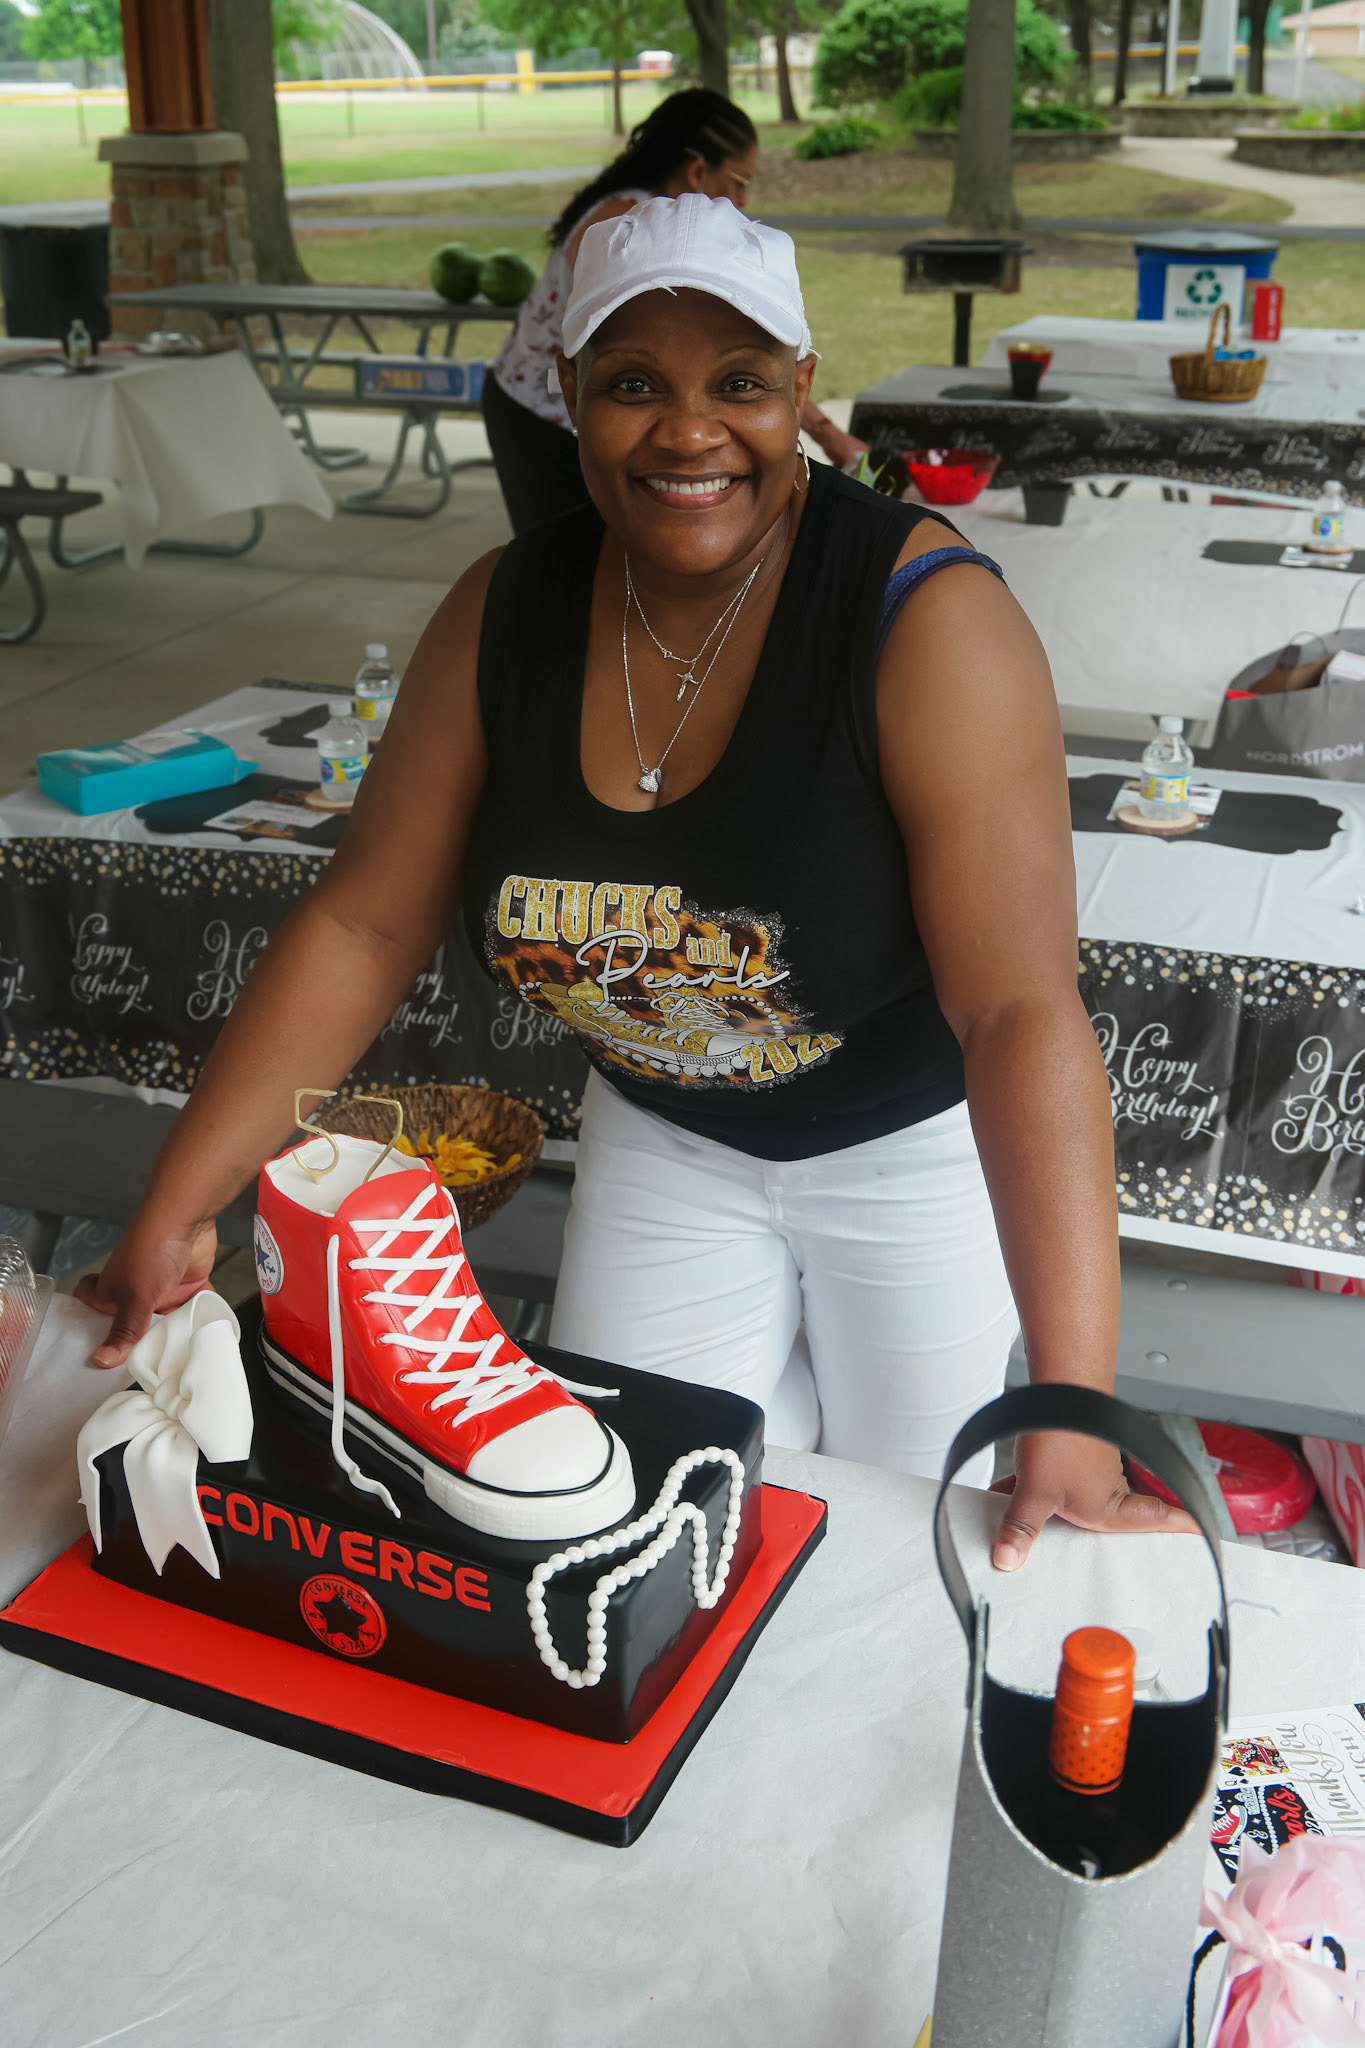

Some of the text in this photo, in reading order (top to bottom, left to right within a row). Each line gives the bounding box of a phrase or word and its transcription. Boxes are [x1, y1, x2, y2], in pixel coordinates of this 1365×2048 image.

[497, 875, 734, 967] CHUCKS and
[576, 929, 790, 1002] Pearls
[739, 1033, 843, 1082] 2021
[1089, 1012, 1215, 1095] Happy
[196, 1484, 492, 1612] CONVERSE
[309, 1582, 369, 1610] CONVERSE
[1267, 1787, 1307, 1848] arls
